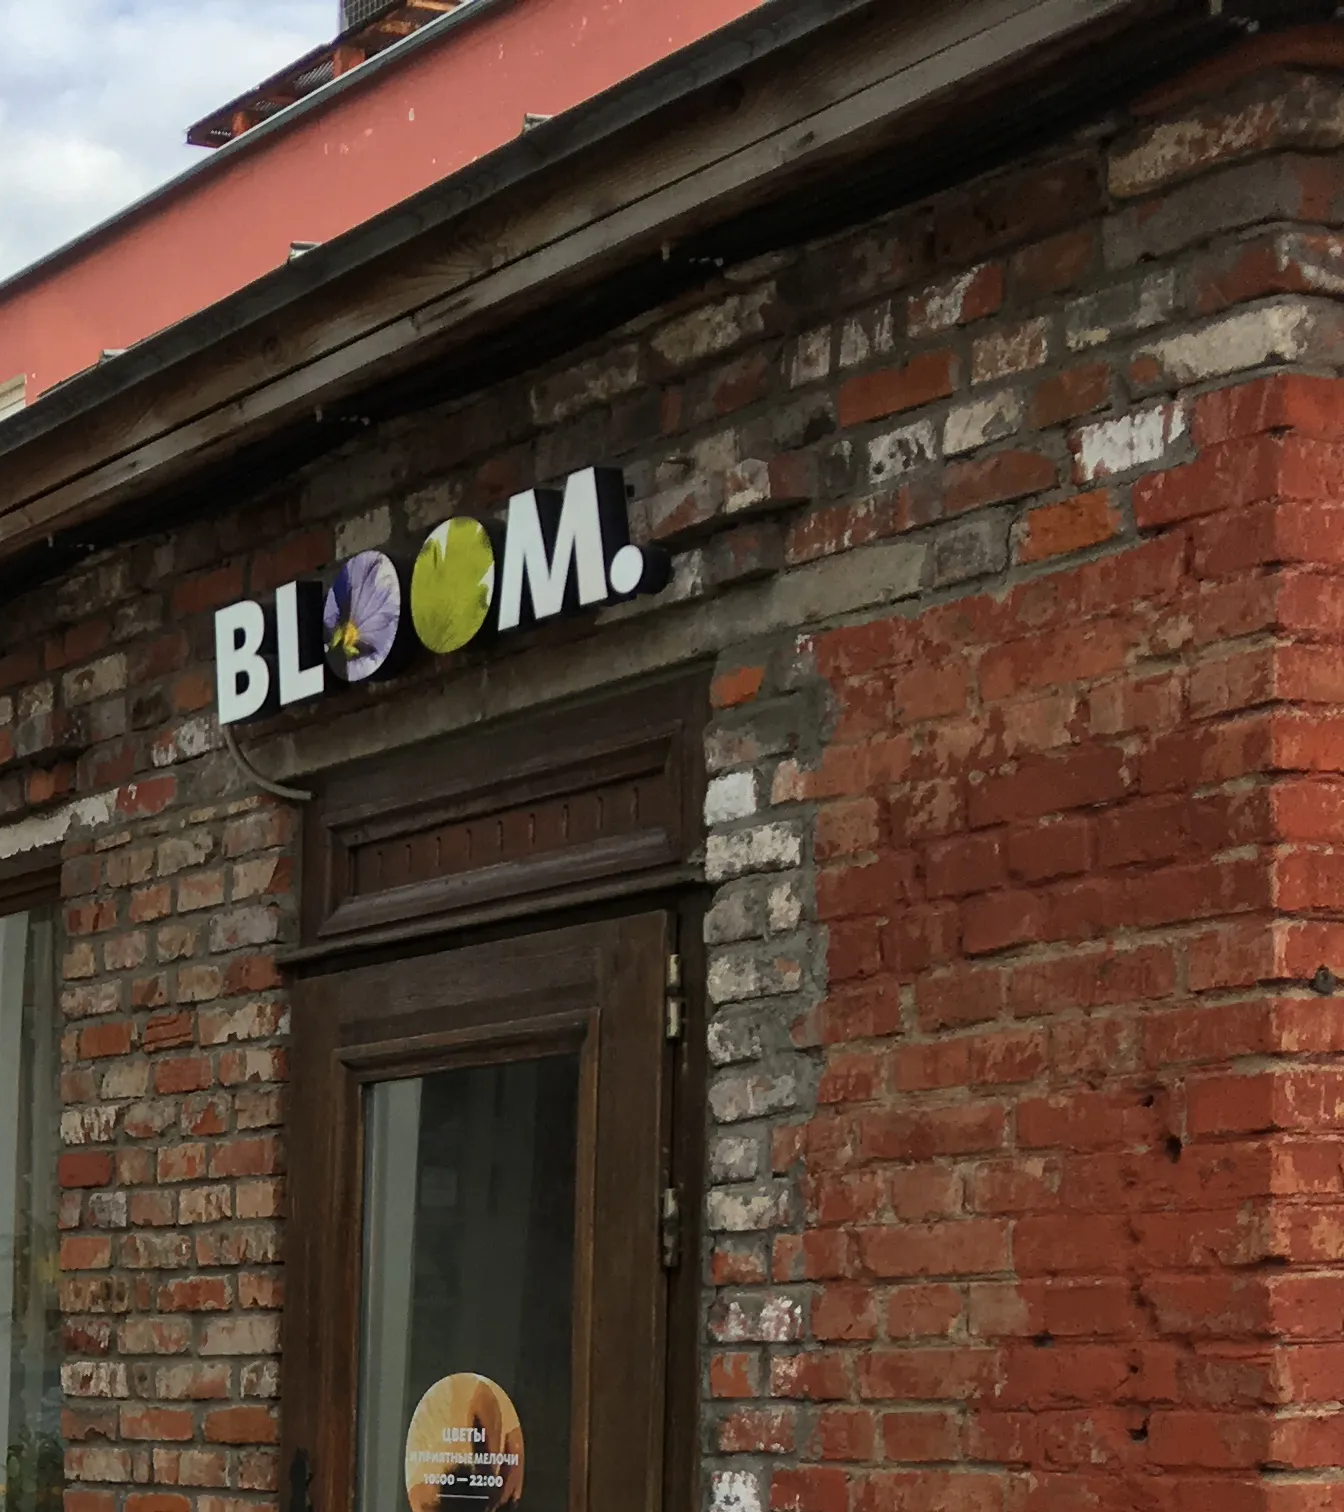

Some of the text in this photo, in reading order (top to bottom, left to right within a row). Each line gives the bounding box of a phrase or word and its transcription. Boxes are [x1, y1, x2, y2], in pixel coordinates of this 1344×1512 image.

[215, 466, 644, 725] BLOOM.
[442, 1428, 486, 1443] ЦВЕТЫ
[474, 1453, 519, 1466] МЕЛОЧИ
[424, 1474, 455, 1486] 10:00
[469, 1475, 503, 1487] 22:00
